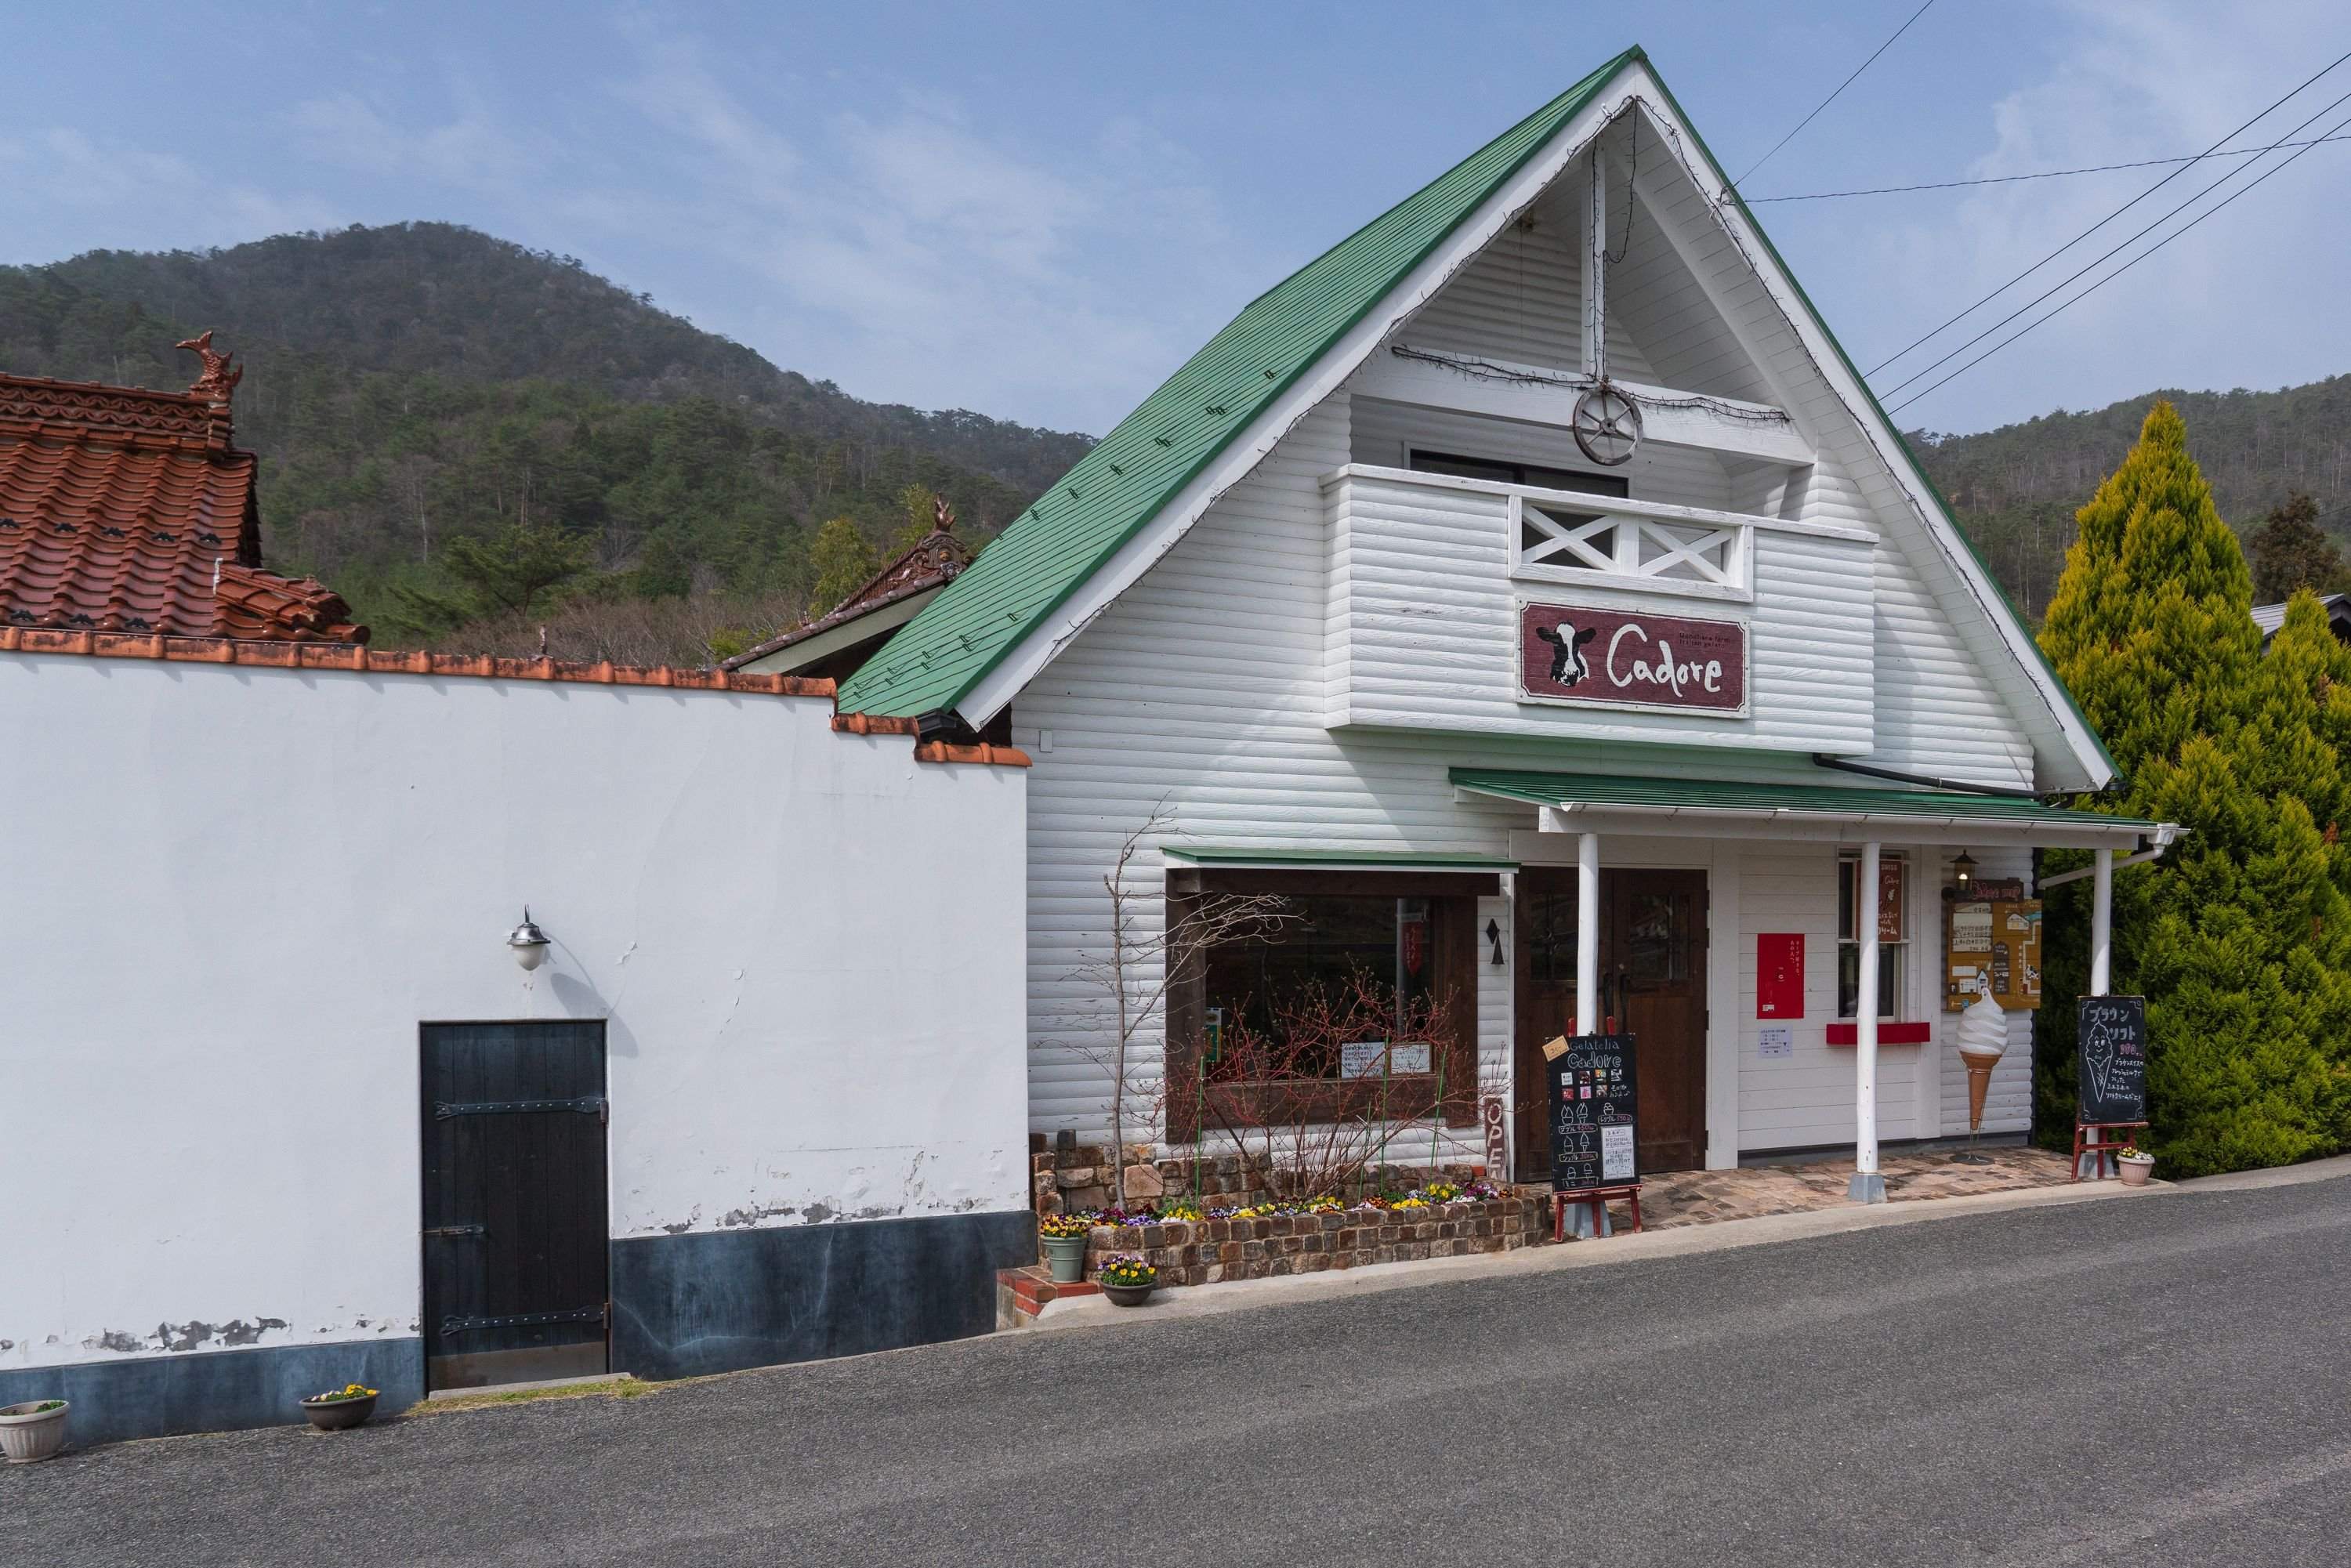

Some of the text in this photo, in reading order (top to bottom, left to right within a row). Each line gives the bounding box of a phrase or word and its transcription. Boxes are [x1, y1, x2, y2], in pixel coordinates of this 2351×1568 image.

[1607, 624, 1722, 697] Cadore
[2089, 1006, 2129, 1022] ブラウン
[2109, 1026, 2135, 1041] ソフト
[1567, 1051, 1622, 1069] Cadore
